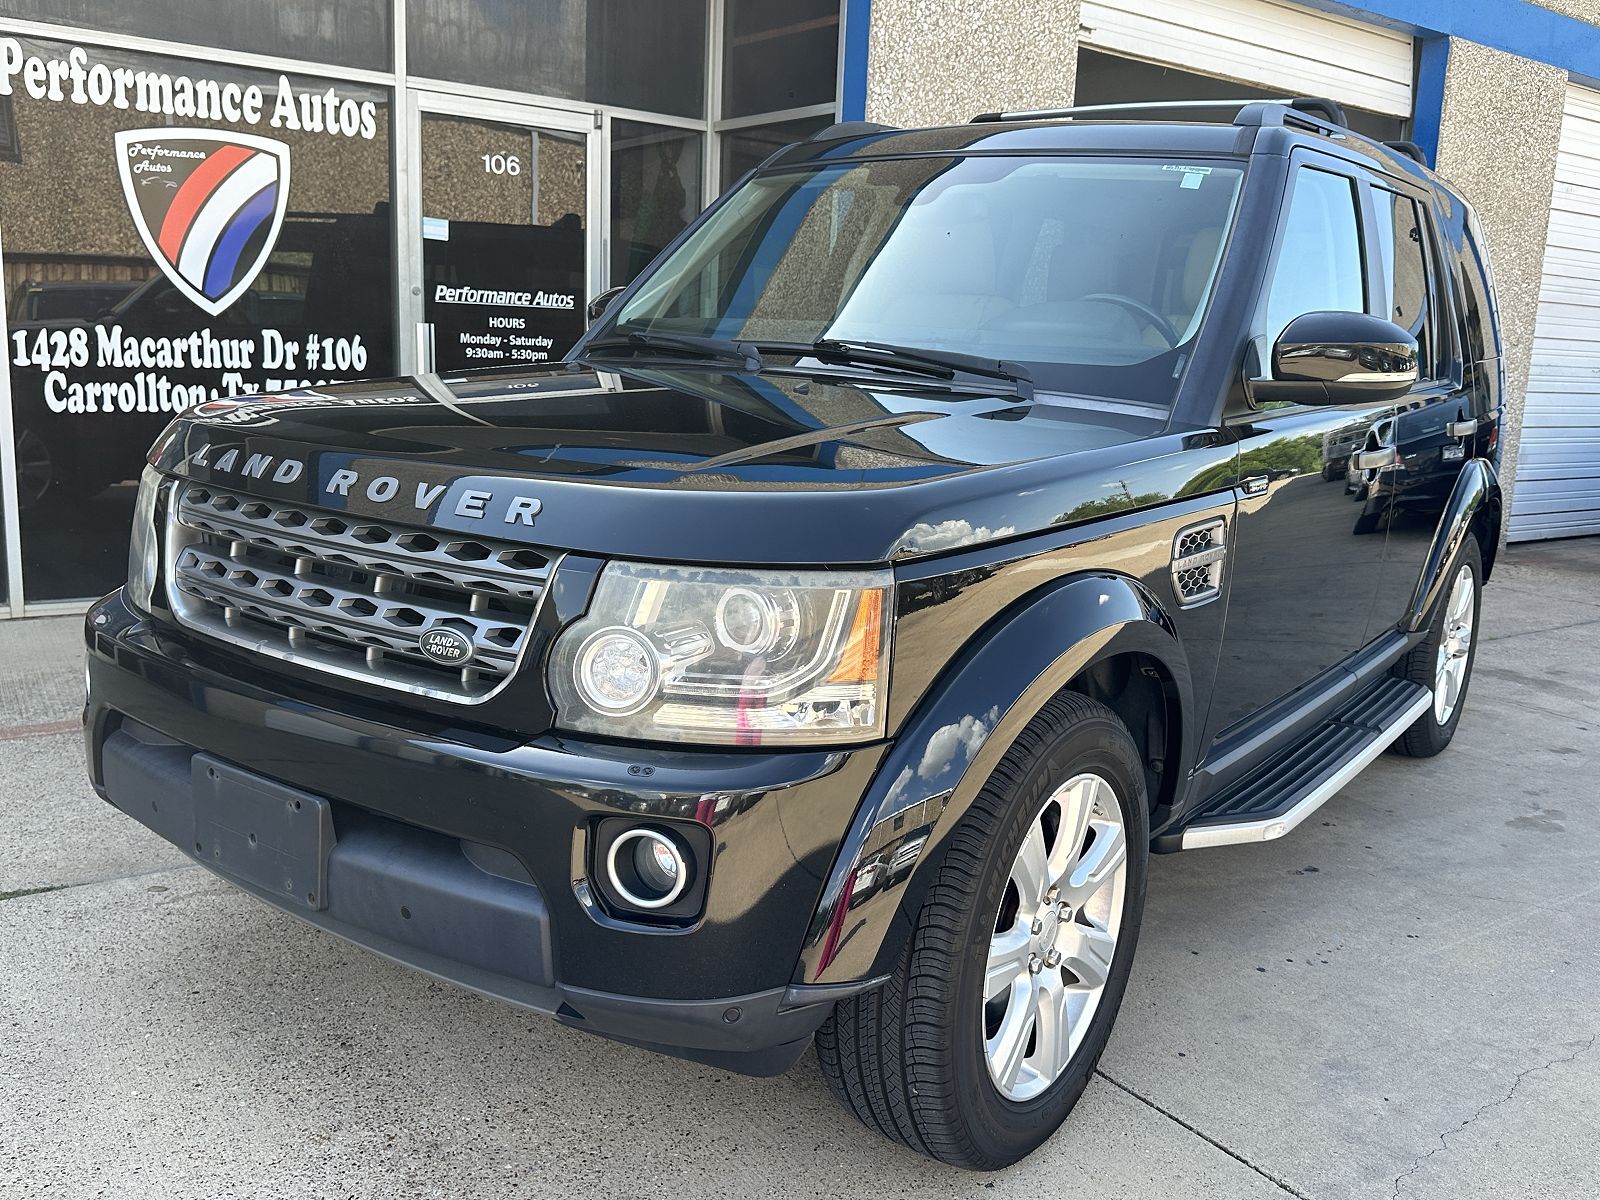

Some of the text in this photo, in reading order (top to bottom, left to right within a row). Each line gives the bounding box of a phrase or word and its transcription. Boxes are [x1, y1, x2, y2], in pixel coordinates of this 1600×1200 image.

[0, 38, 377, 139] Performance Autos
[128, 143, 206, 160] Performance
[133, 160, 172, 174] Autos
[481, 154, 521, 176] 106
[435, 285, 575, 308] Performance Autos
[489, 317, 525, 329] HOURS
[12, 325, 367, 371] 1428 Macarthur Dr #106
[460, 333, 502, 345] Monday
[509, 335, 553, 348] Saturday
[465, 348, 504, 359] 9:30am
[511, 349, 548, 361] 5:30pm
[192, 442, 543, 527] LAND ROVER
[429, 634, 454, 647] LAND
[430, 645, 460, 658] ROVER
[987, 762, 1053, 904] MICHELIN
